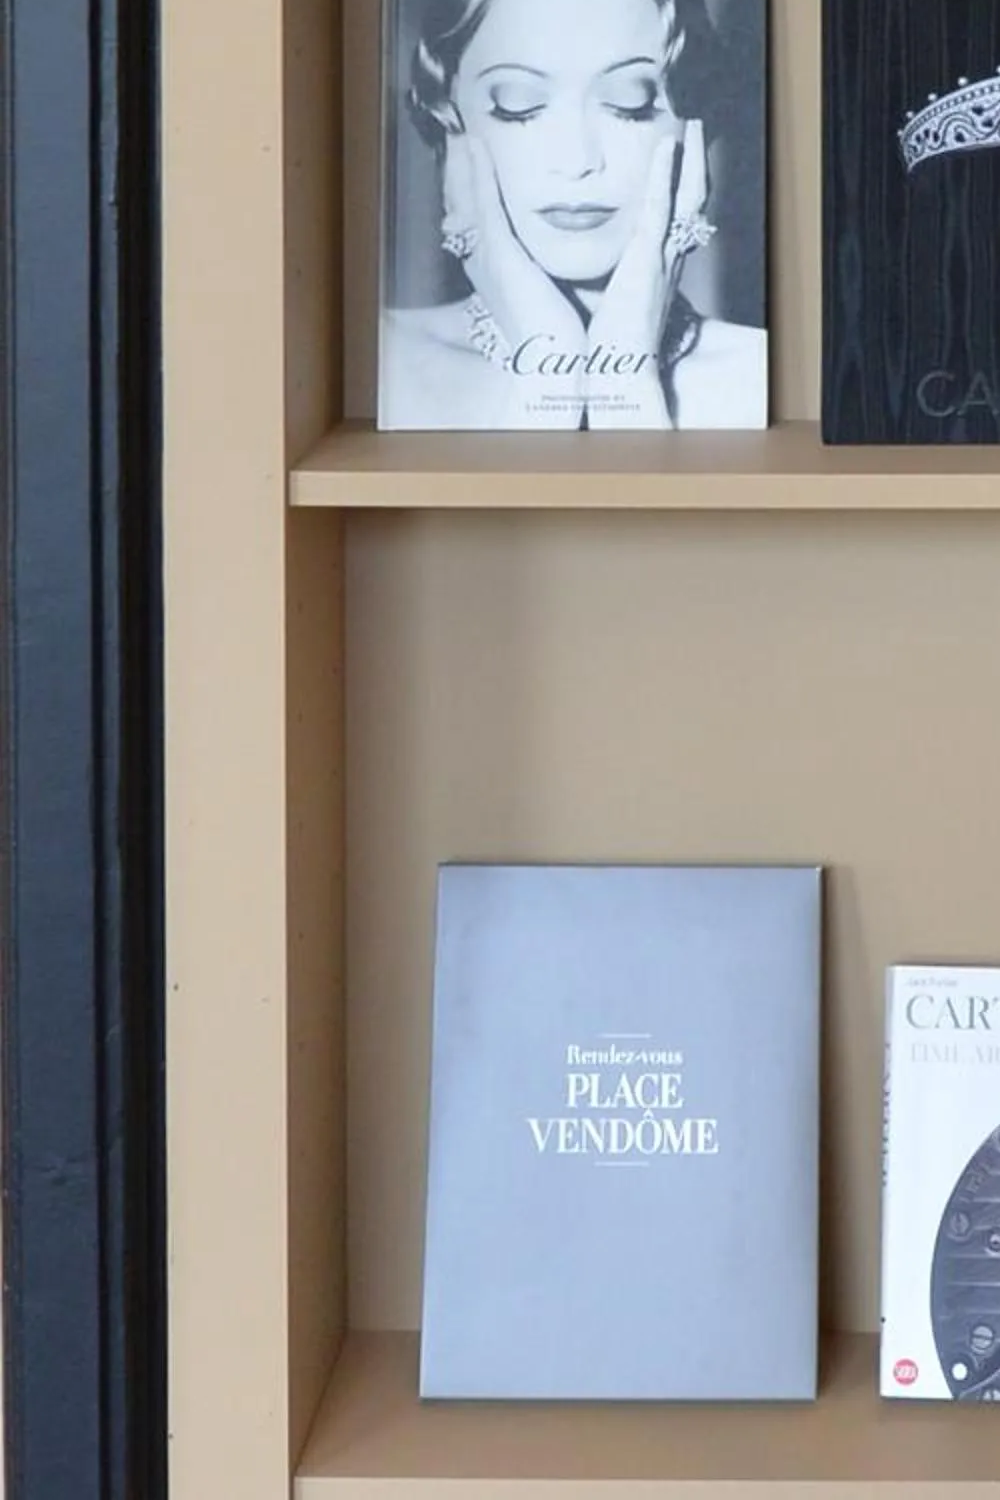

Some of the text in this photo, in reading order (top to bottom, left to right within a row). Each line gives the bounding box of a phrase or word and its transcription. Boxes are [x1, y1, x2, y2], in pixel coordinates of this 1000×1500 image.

[511, 332, 657, 375] Cartier
[566, 1043, 684, 1066] Rendez-vous
[566, 1072, 683, 1107] PLACE
[527, 1107, 719, 1155] VENDÔME
